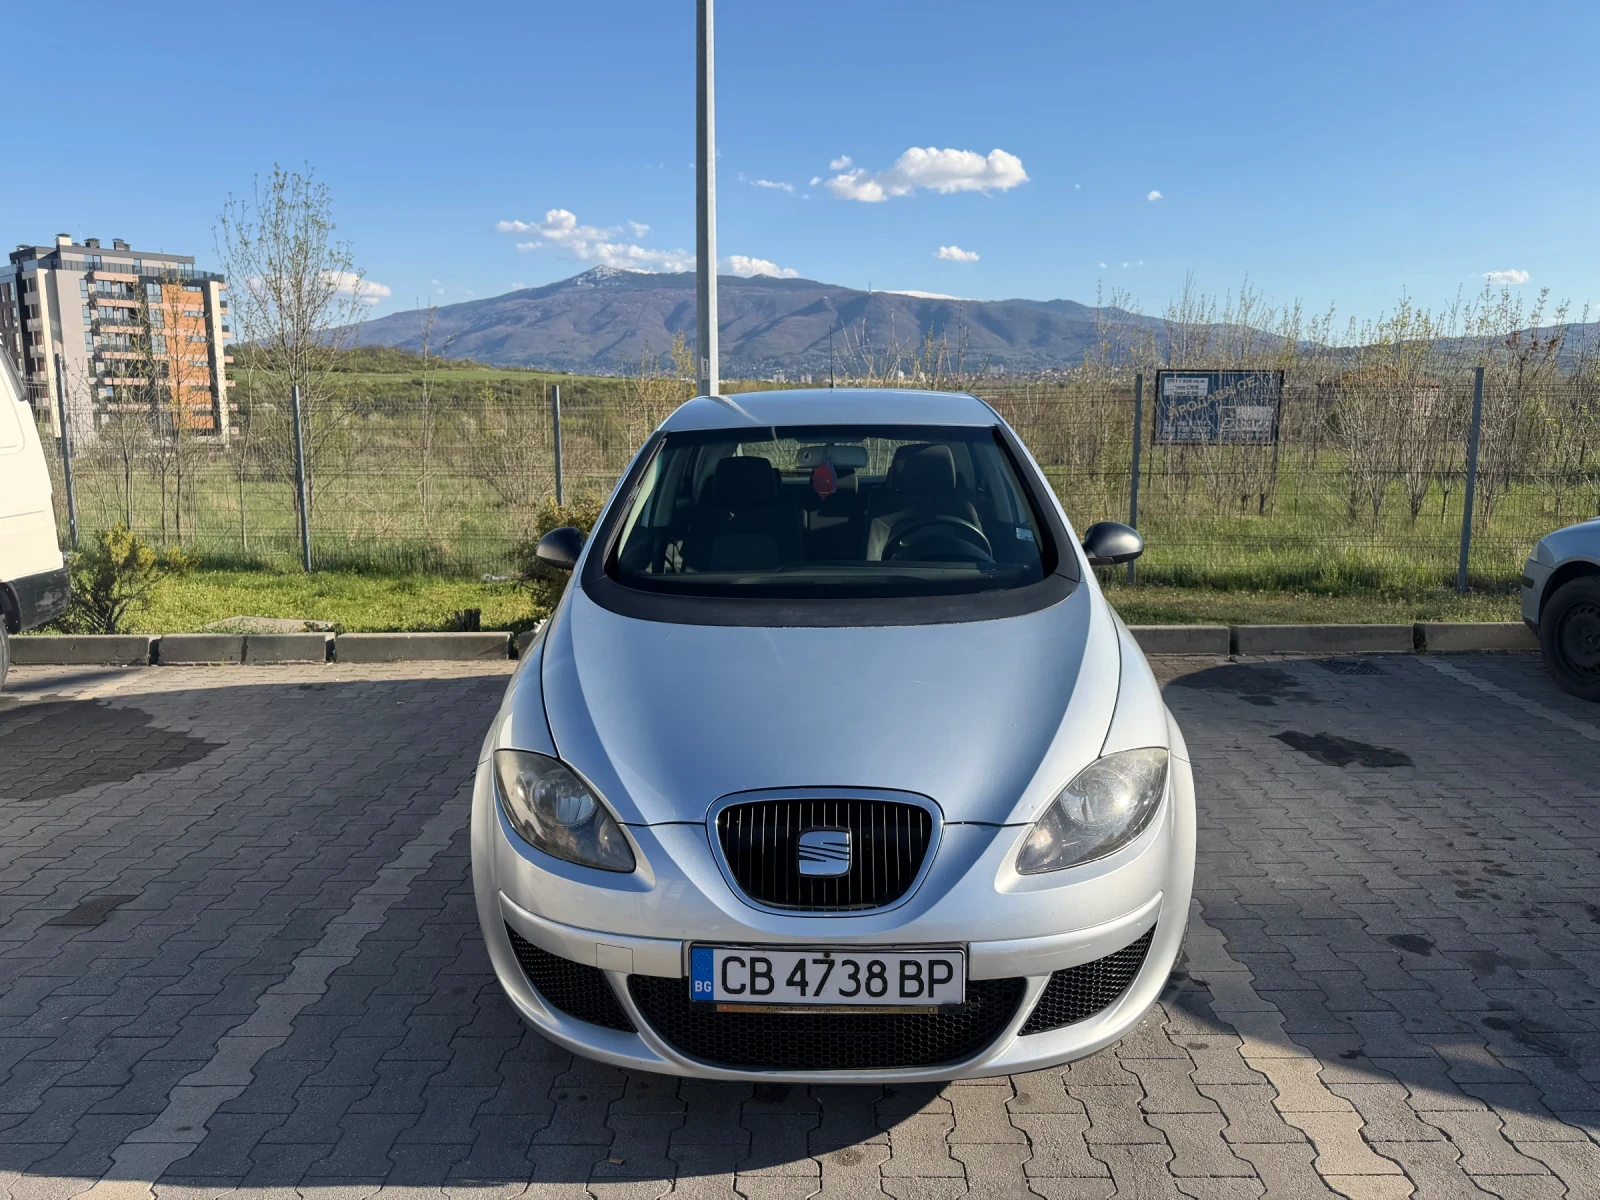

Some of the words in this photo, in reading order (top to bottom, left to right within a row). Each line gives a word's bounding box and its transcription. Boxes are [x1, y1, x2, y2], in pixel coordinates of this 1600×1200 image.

[695, 980, 712, 993] BG
[721, 955, 775, 996] CB
[785, 958, 889, 998] 4738
[899, 959, 954, 998] BP
